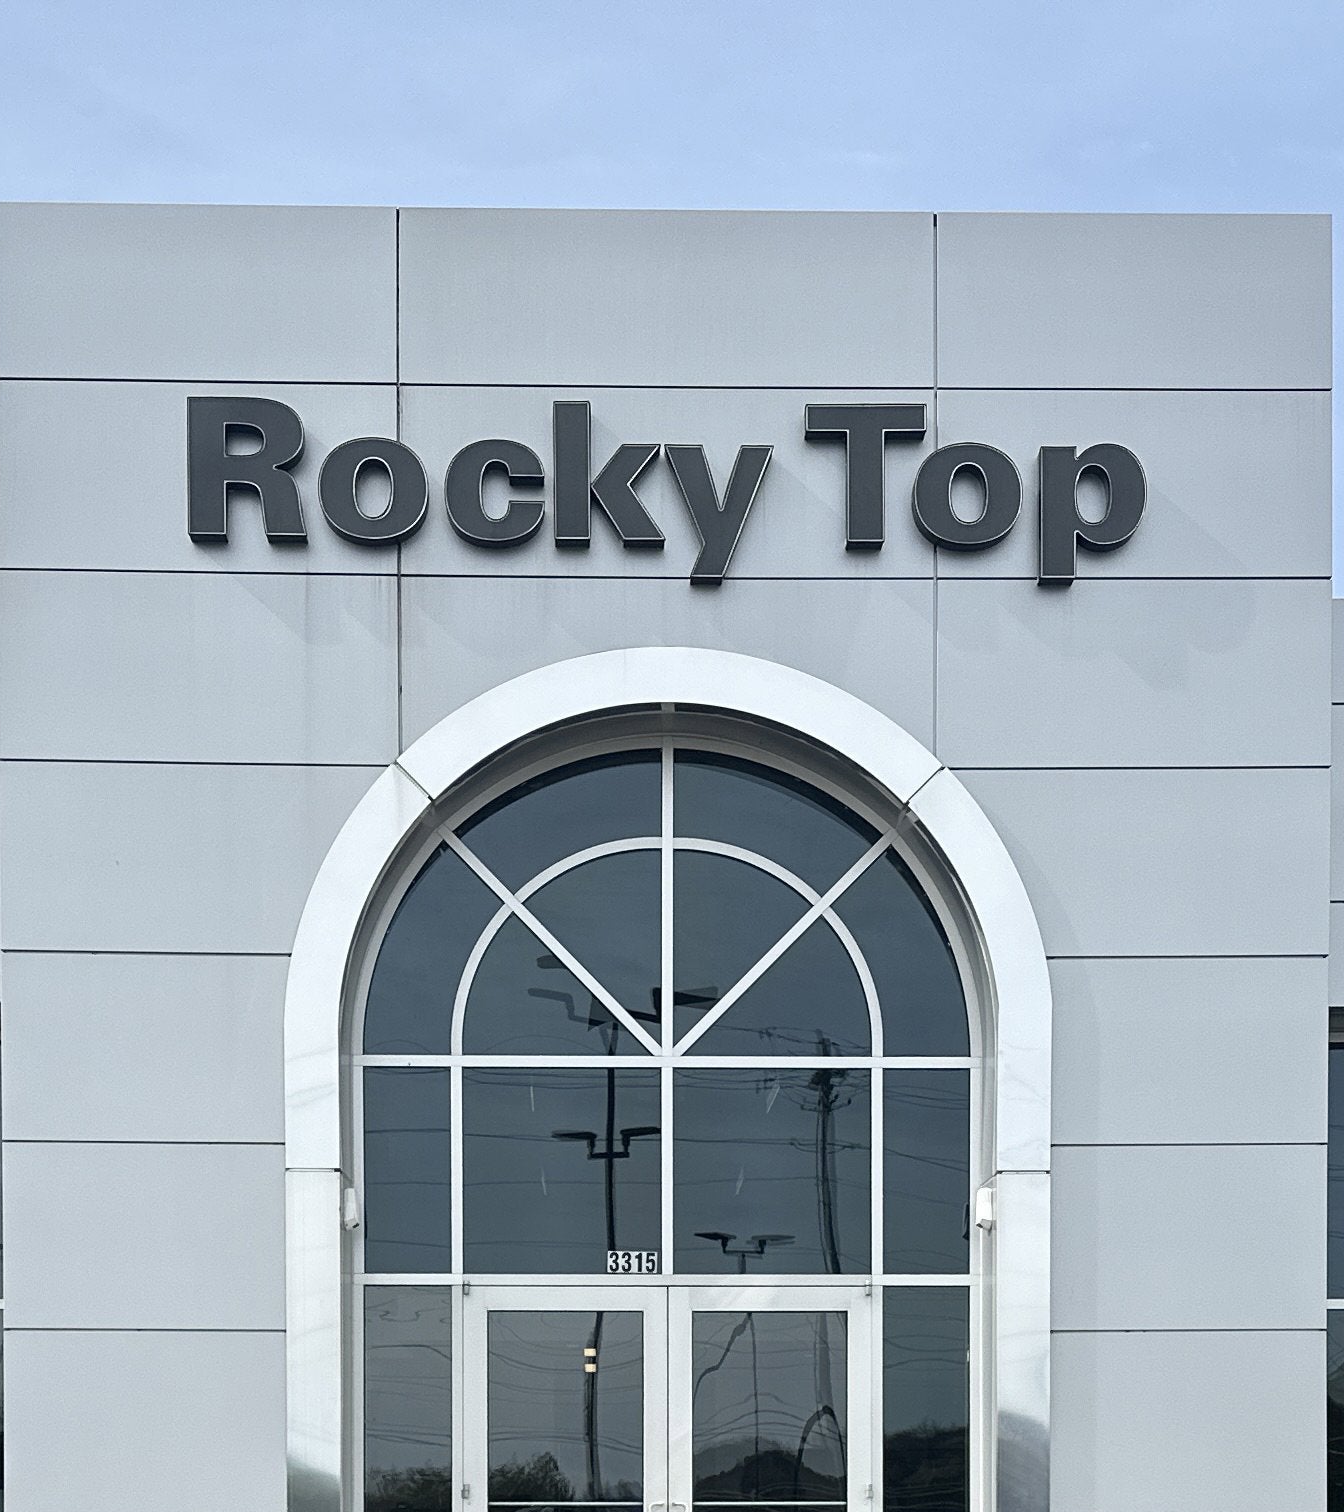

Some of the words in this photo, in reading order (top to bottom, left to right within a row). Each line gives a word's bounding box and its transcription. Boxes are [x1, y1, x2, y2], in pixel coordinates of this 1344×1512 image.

[187, 396, 774, 585] Rocky
[804, 403, 1148, 585] Top
[609, 1251, 656, 1273] 3315
